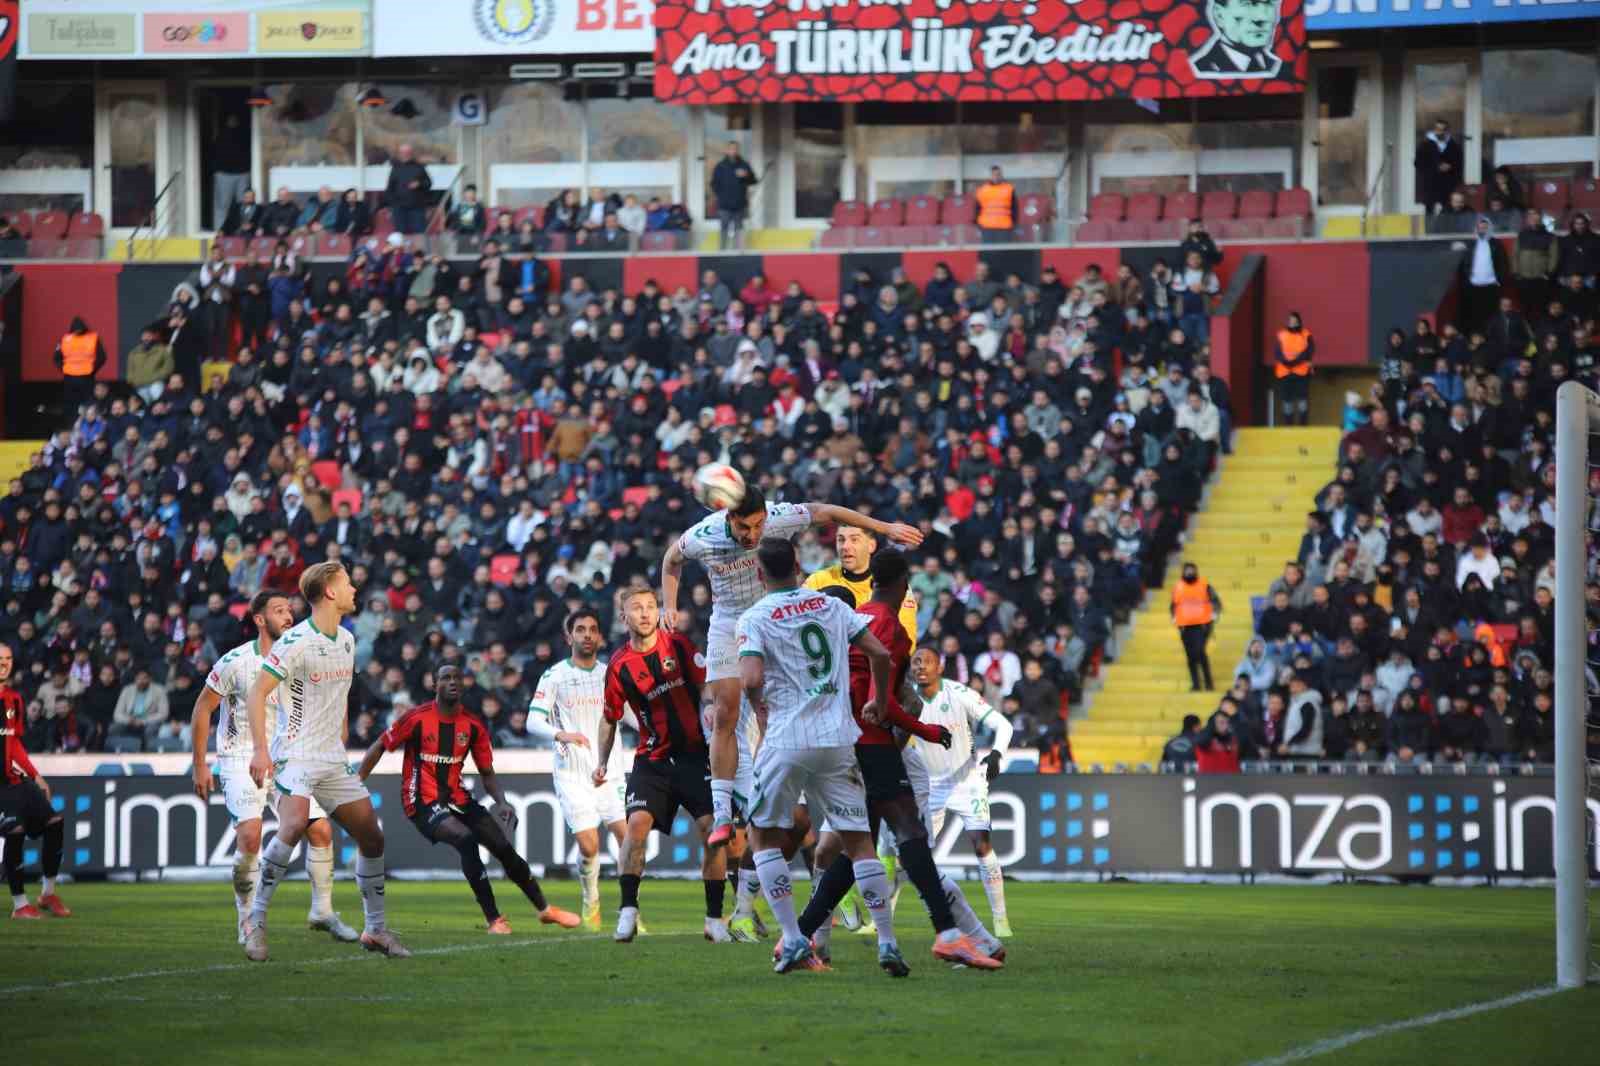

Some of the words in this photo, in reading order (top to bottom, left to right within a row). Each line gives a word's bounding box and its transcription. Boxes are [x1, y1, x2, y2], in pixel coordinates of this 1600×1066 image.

[671, 32, 765, 75] Ama
[769, 19, 973, 74] TÜRKLÜK
[979, 21, 1163, 69] Ebedidir
[458, 95, 480, 119] G
[800, 621, 832, 679] 9
[1183, 778, 1393, 871] imza
